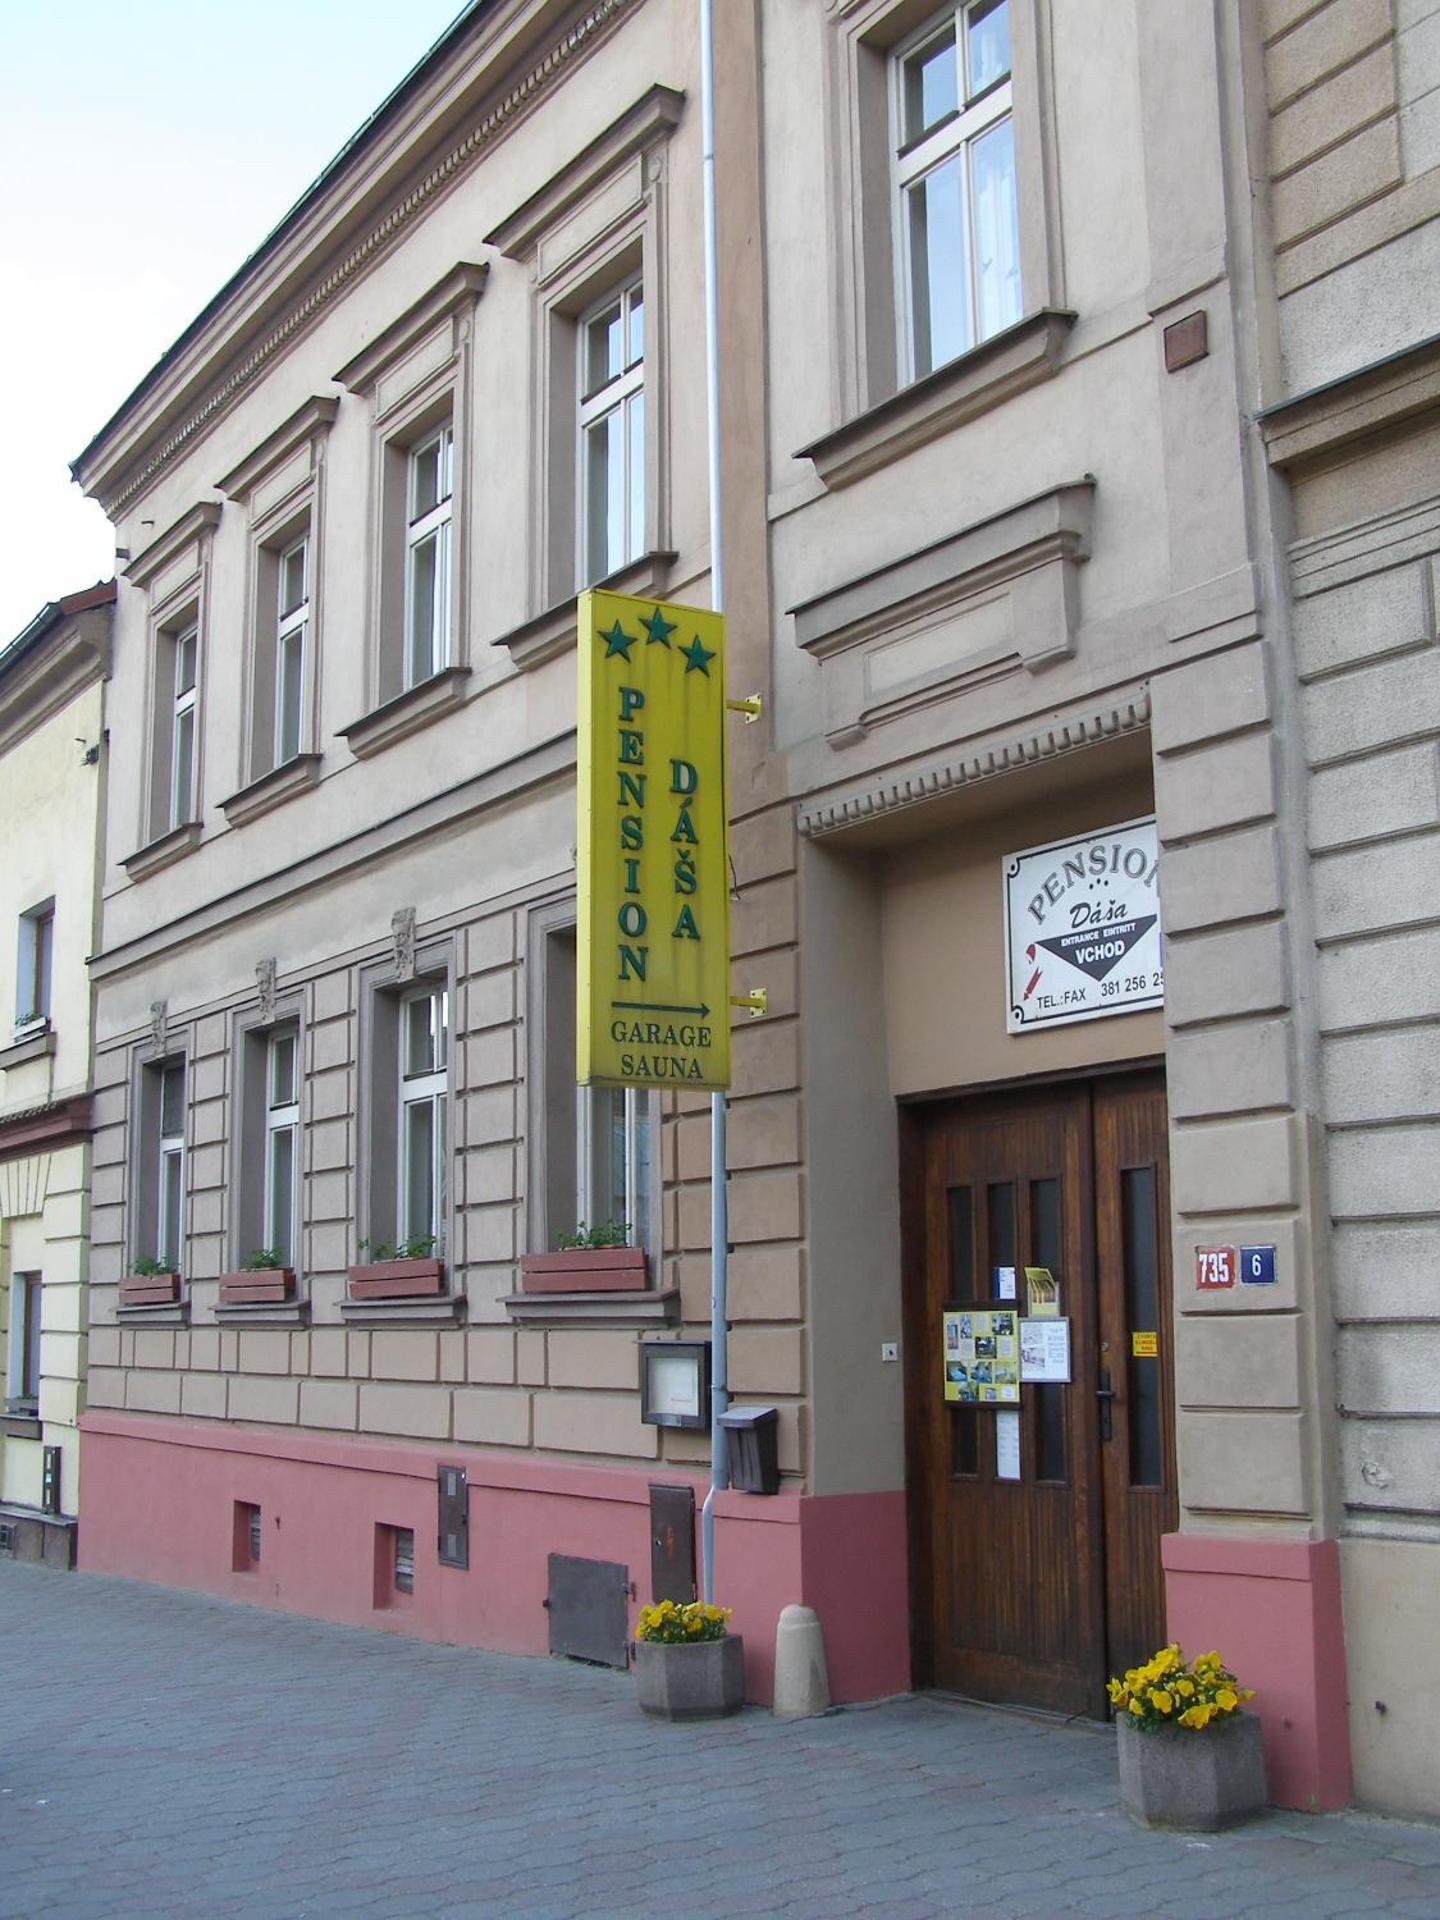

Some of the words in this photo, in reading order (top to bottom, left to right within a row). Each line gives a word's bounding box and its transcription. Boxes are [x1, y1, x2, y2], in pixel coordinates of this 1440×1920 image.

[617, 686, 648, 981] PENSION
[669, 757, 701, 941] DÁŠA
[1069, 899, 1128, 929] Dáša
[1060, 931, 1099, 947] ENTRANCE
[1103, 922, 1137, 937] EINTRITT
[1074, 940, 1126, 964] VCHOD
[1101, 981, 1120, 997] 381
[1125, 975, 1147, 992] 256
[611, 1020, 712, 1049] GARAGE
[620, 1054, 704, 1080] SAUNA
[1199, 1253, 1229, 1283] 735
[1252, 1254, 1262, 1276] 6
